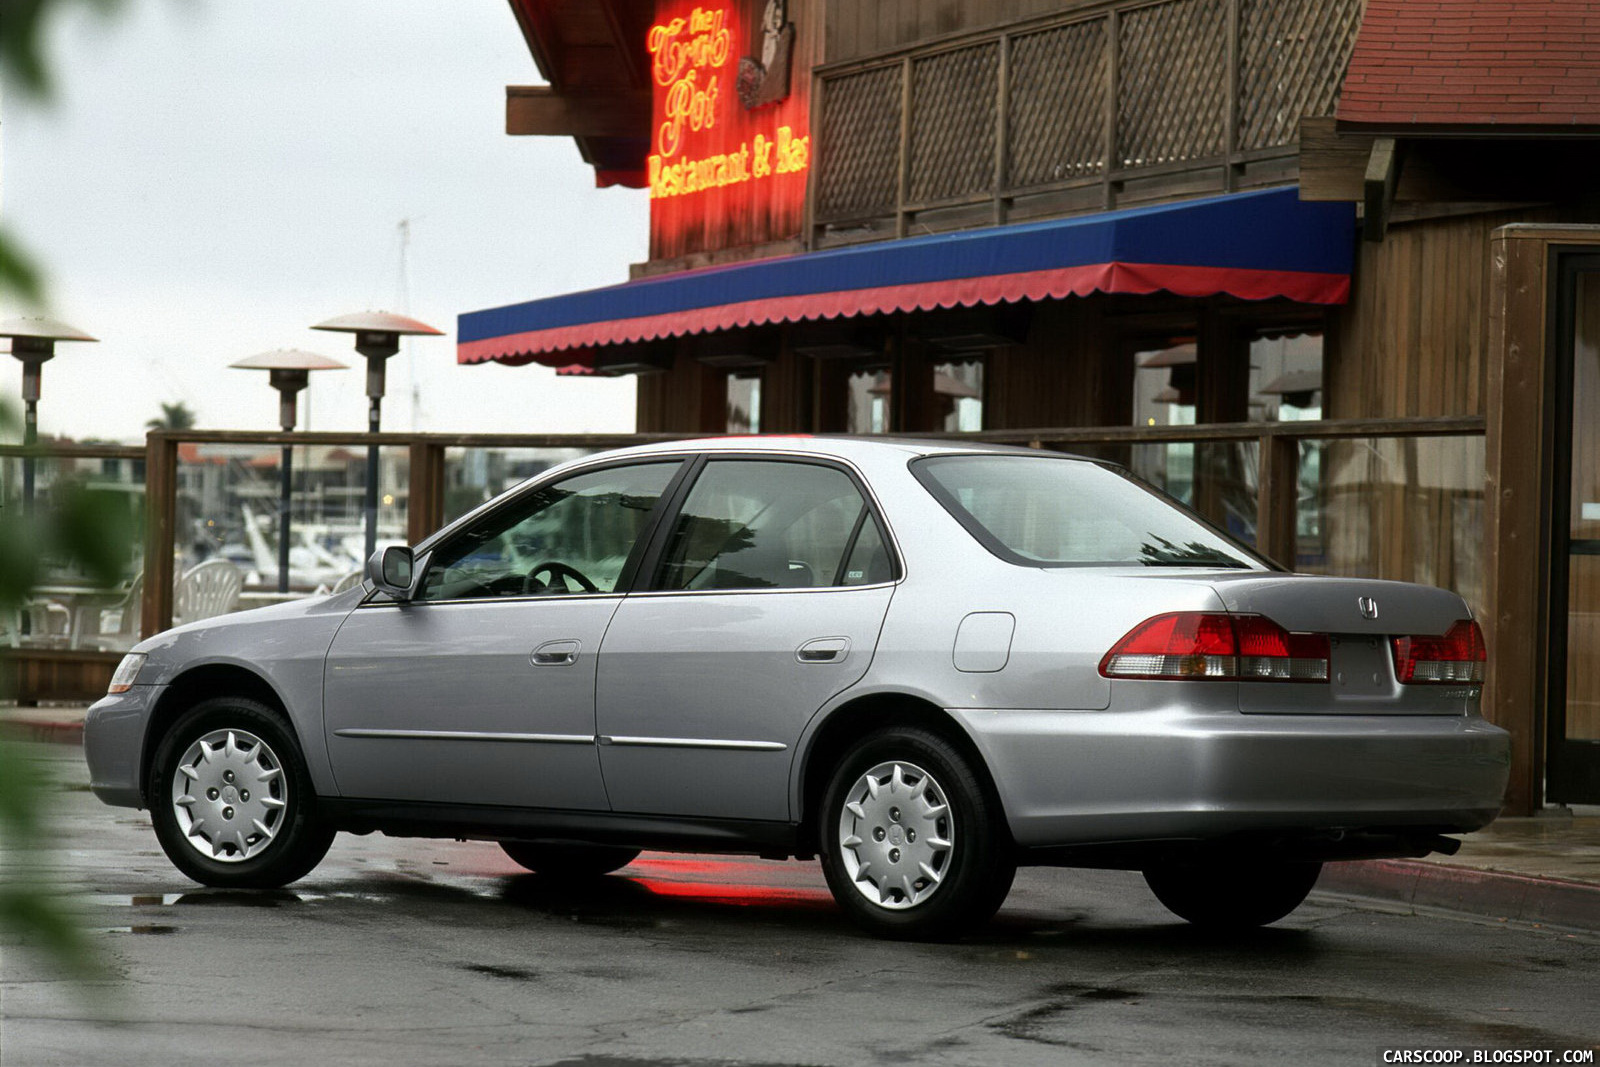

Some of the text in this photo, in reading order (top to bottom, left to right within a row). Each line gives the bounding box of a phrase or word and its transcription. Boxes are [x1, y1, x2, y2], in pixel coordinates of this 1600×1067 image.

[659, 69, 719, 158] Pot
[649, 142, 750, 199] Restaurant
[753, 134, 774, 178] &
